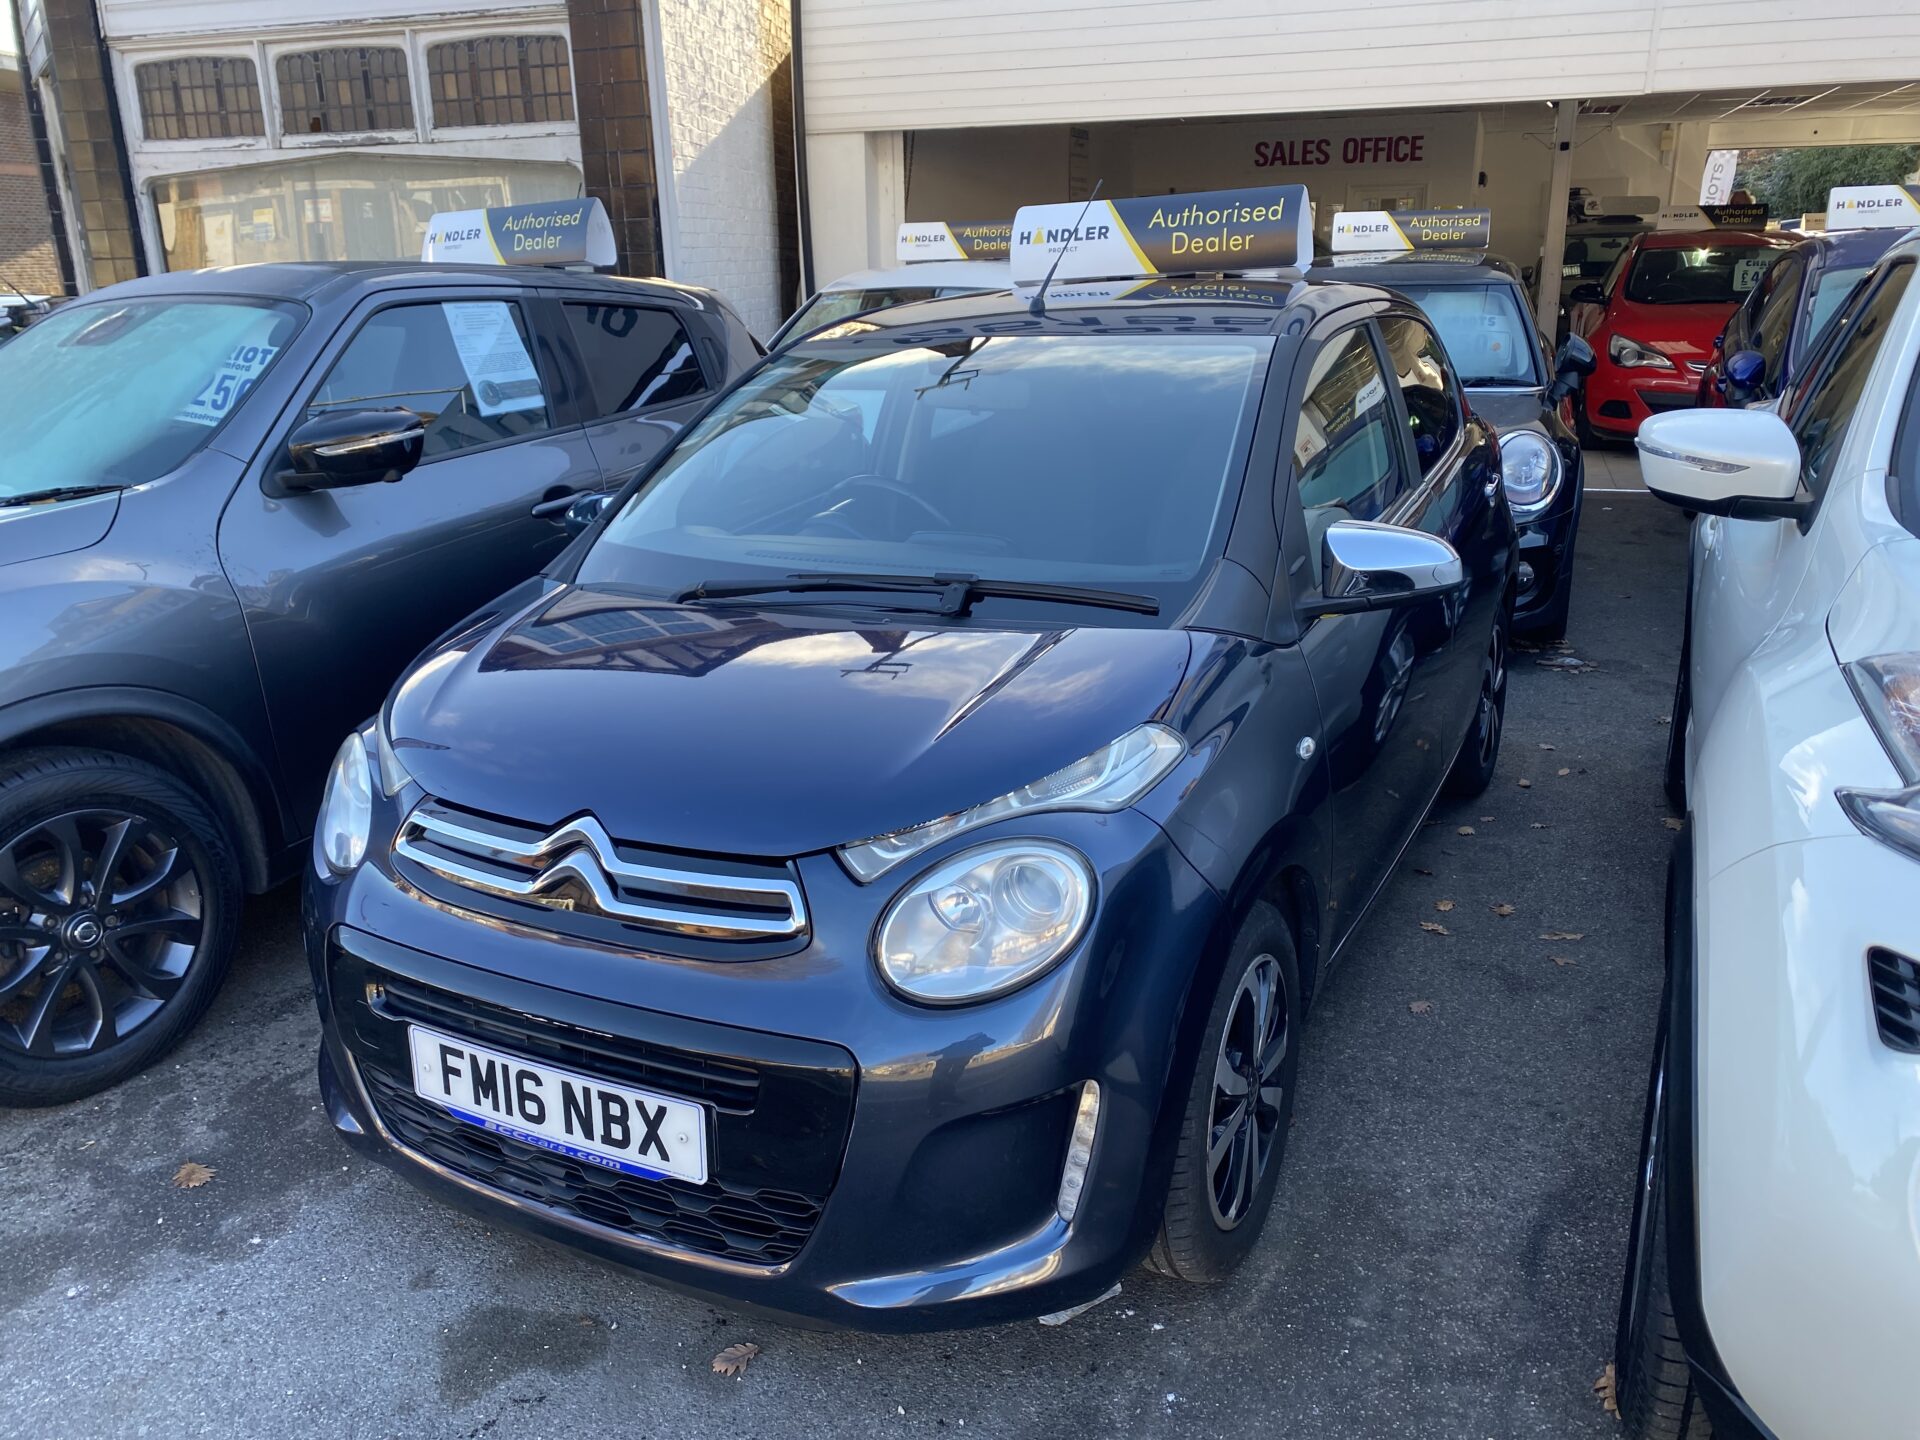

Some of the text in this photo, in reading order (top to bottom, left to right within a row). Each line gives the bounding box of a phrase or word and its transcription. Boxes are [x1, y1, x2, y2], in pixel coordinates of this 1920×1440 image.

[1254, 135, 1425, 167] SALES OFFICE
[502, 207, 583, 232] Authorised
[1146, 197, 1285, 229] Authorised
[1410, 214, 1481, 228] Authorised
[1714, 208, 1764, 218] Authorised
[1721, 216, 1753, 225] Dealer
[514, 230, 562, 251] Dealer
[963, 226, 1013, 238] Authoris
[1171, 228, 1255, 255] Dealer
[1422, 228, 1466, 241] Dealer
[438, 1043, 671, 1163] FM16 NBX
